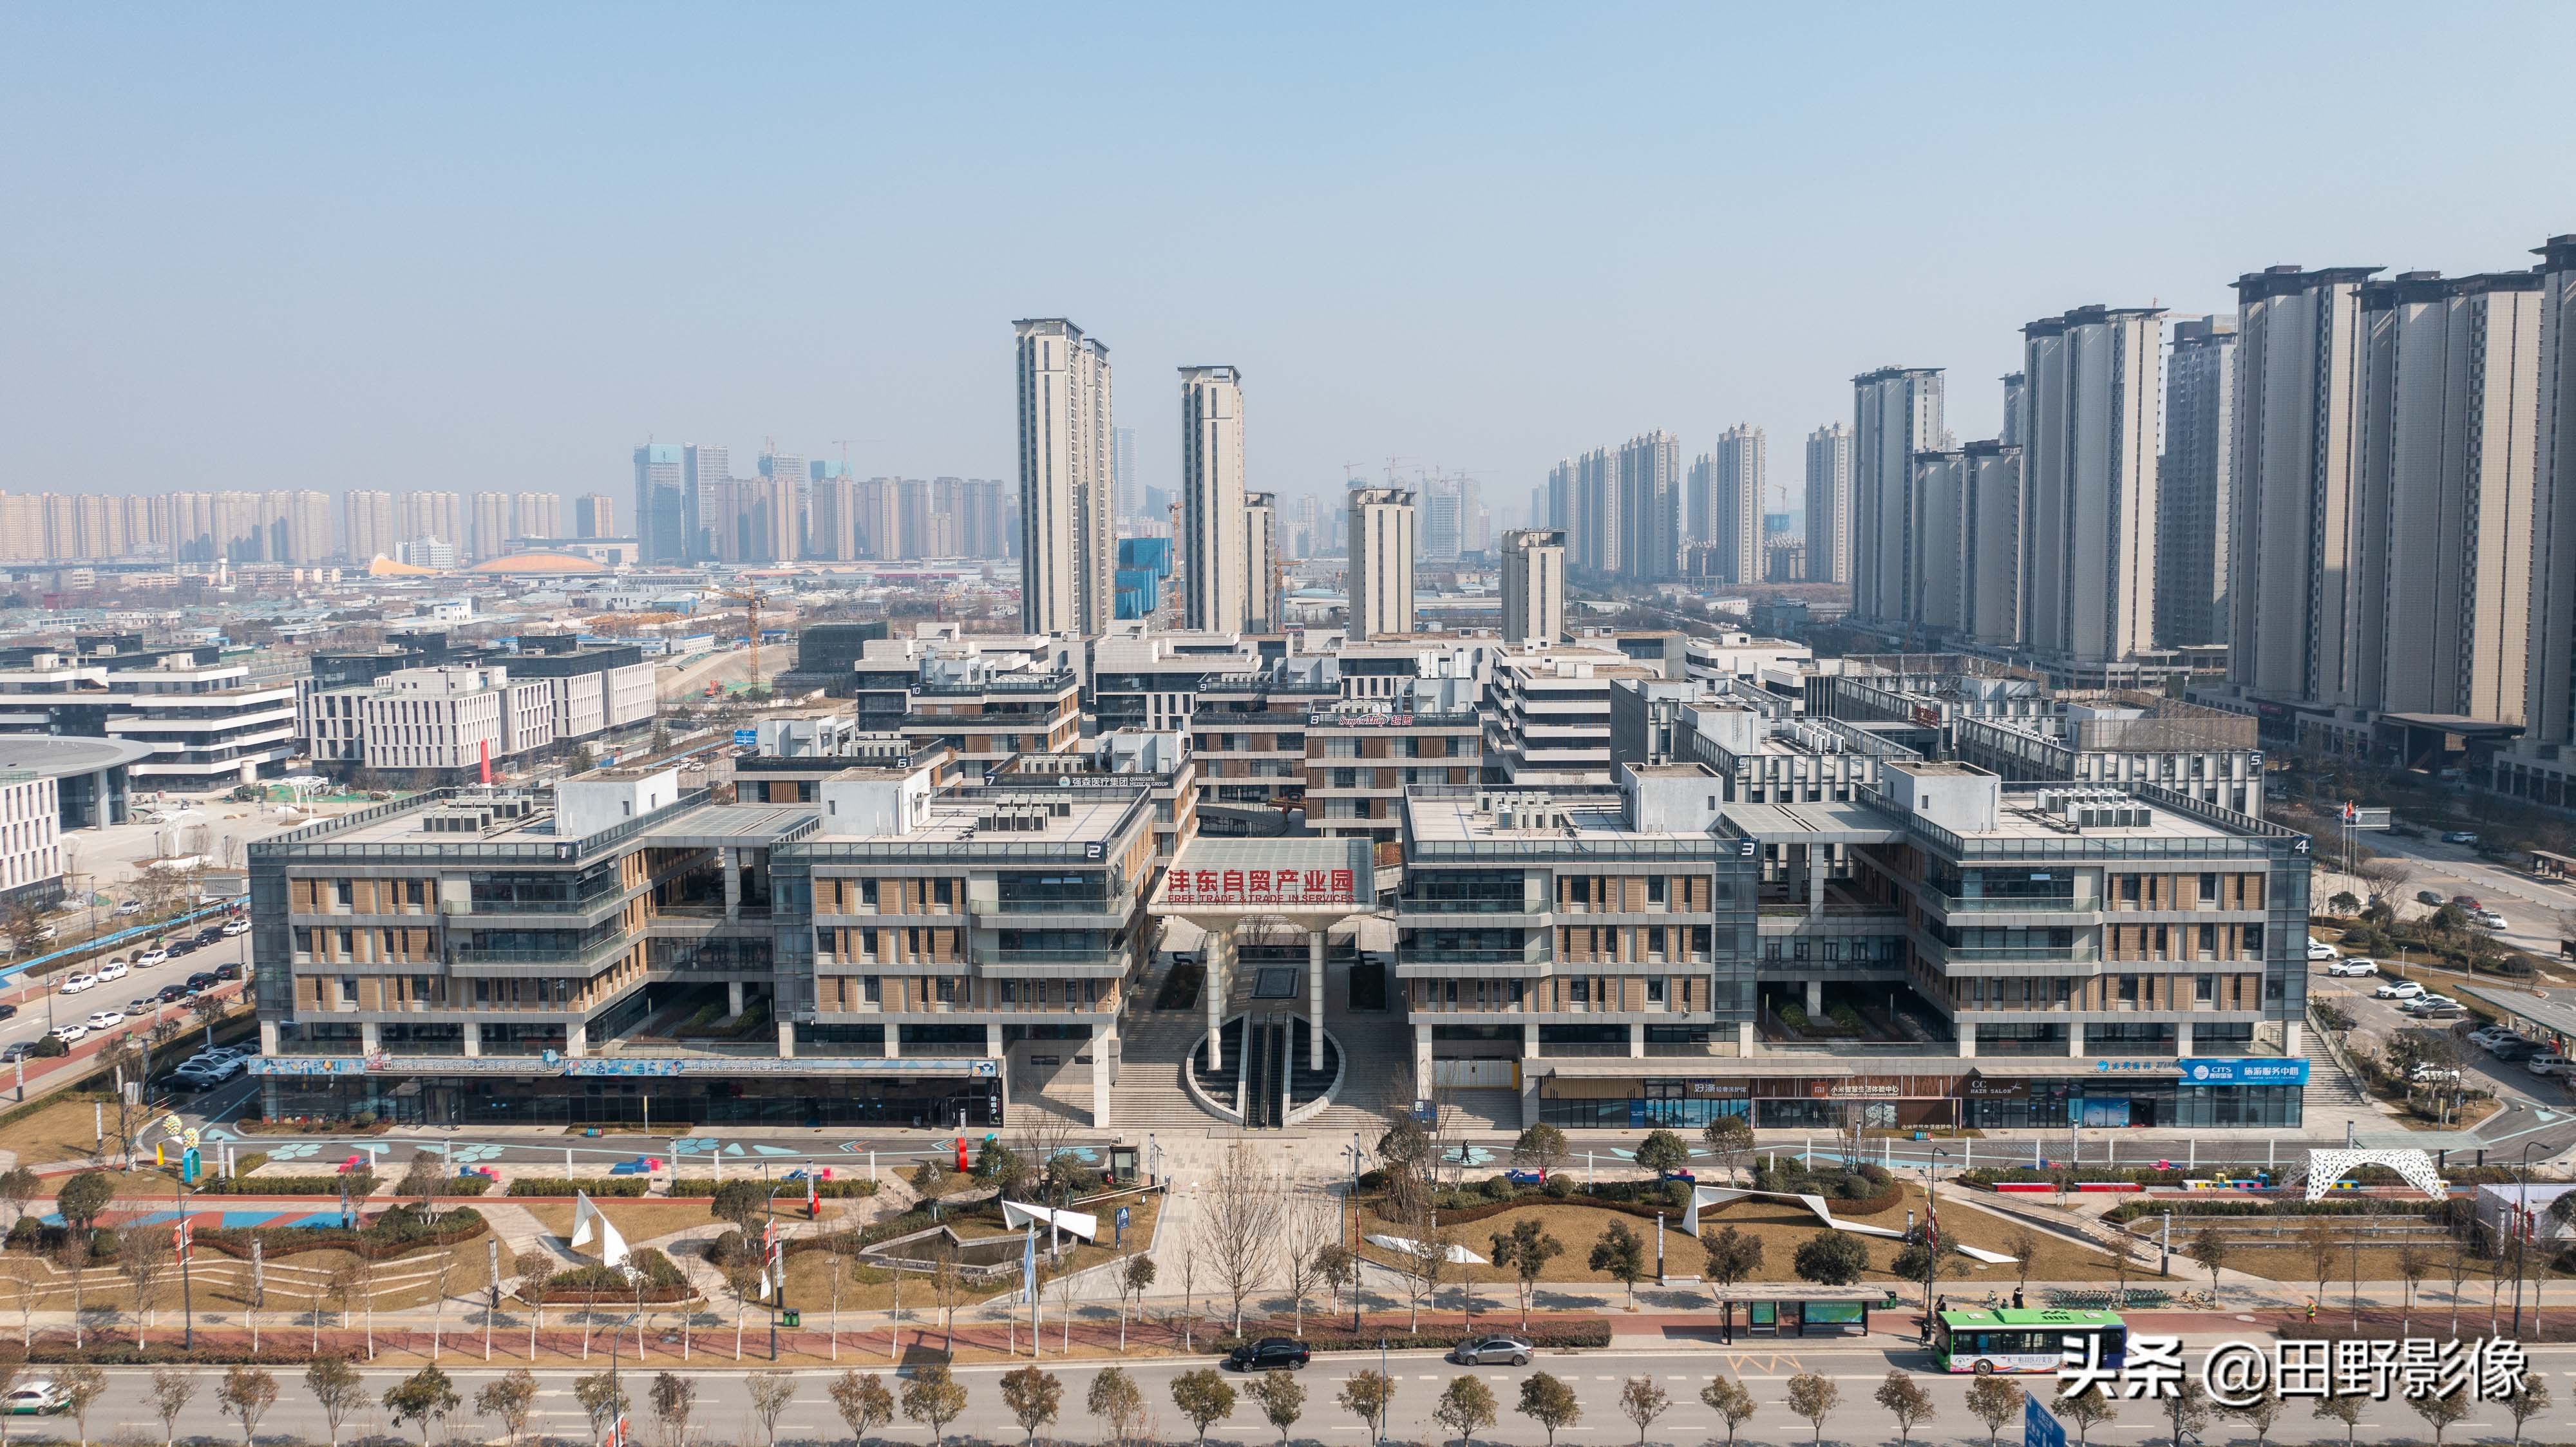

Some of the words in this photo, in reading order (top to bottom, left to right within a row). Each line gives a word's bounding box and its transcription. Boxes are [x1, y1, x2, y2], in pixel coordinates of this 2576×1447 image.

[1311, 716, 1320, 724] 8
[1338, 715, 1387, 727] SuperMap
[1391, 715, 1412, 726] 超图
[898, 759, 907, 768] 6
[910, 757, 913, 766] 6
[1738, 757, 1747, 768] 5
[985, 777, 995, 786] 7
[1072, 777, 1128, 786] 强森医疗集团
[578, 844, 582, 857] 1
[1087, 845, 1102, 858] 2
[1741, 842, 1755, 856] 3
[2295, 840, 2309, 853] 4
[561, 846, 567, 858] 1
[1168, 869, 1353, 892] 沣东自贸产业园
[1168, 894, 1195, 903] FREE
[1200, 894, 1235, 903] TRADE
[1240, 894, 1246, 903] &
[1248, 894, 1283, 903] TRADE
[1289, 894, 1298, 903] IN
[1302, 894, 1354, 903] SERVICES
[2244, 1066, 2299, 1076] 旅游服务中心
[1831, 1085, 1899, 1093] 小米智慧生活体验中心
